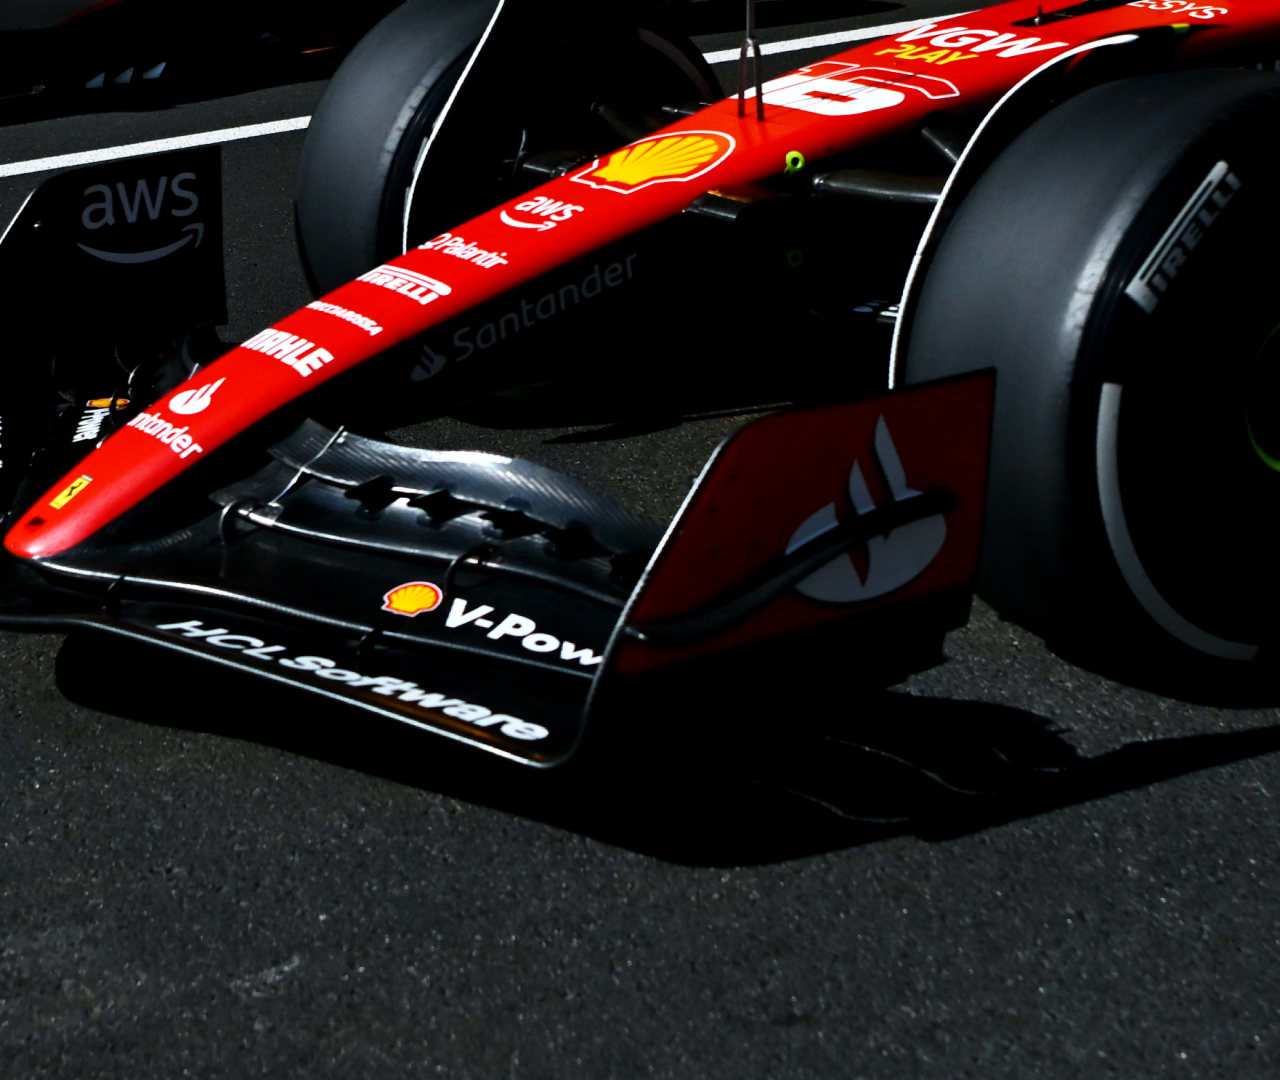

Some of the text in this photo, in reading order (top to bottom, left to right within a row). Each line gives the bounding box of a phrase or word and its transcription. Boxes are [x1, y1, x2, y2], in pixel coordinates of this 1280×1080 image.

[873, 43, 980, 66] PLAY
[893, 23, 1070, 59] VGW
[80, 171, 201, 232] aws
[514, 195, 585, 221] aws
[441, 236, 509, 269] Palantir
[1123, 158, 1244, 315] PIRELLI
[451, 249, 639, 363] Santander
[126, 411, 204, 459] ntander
[442, 596, 607, 669] V-Pow
